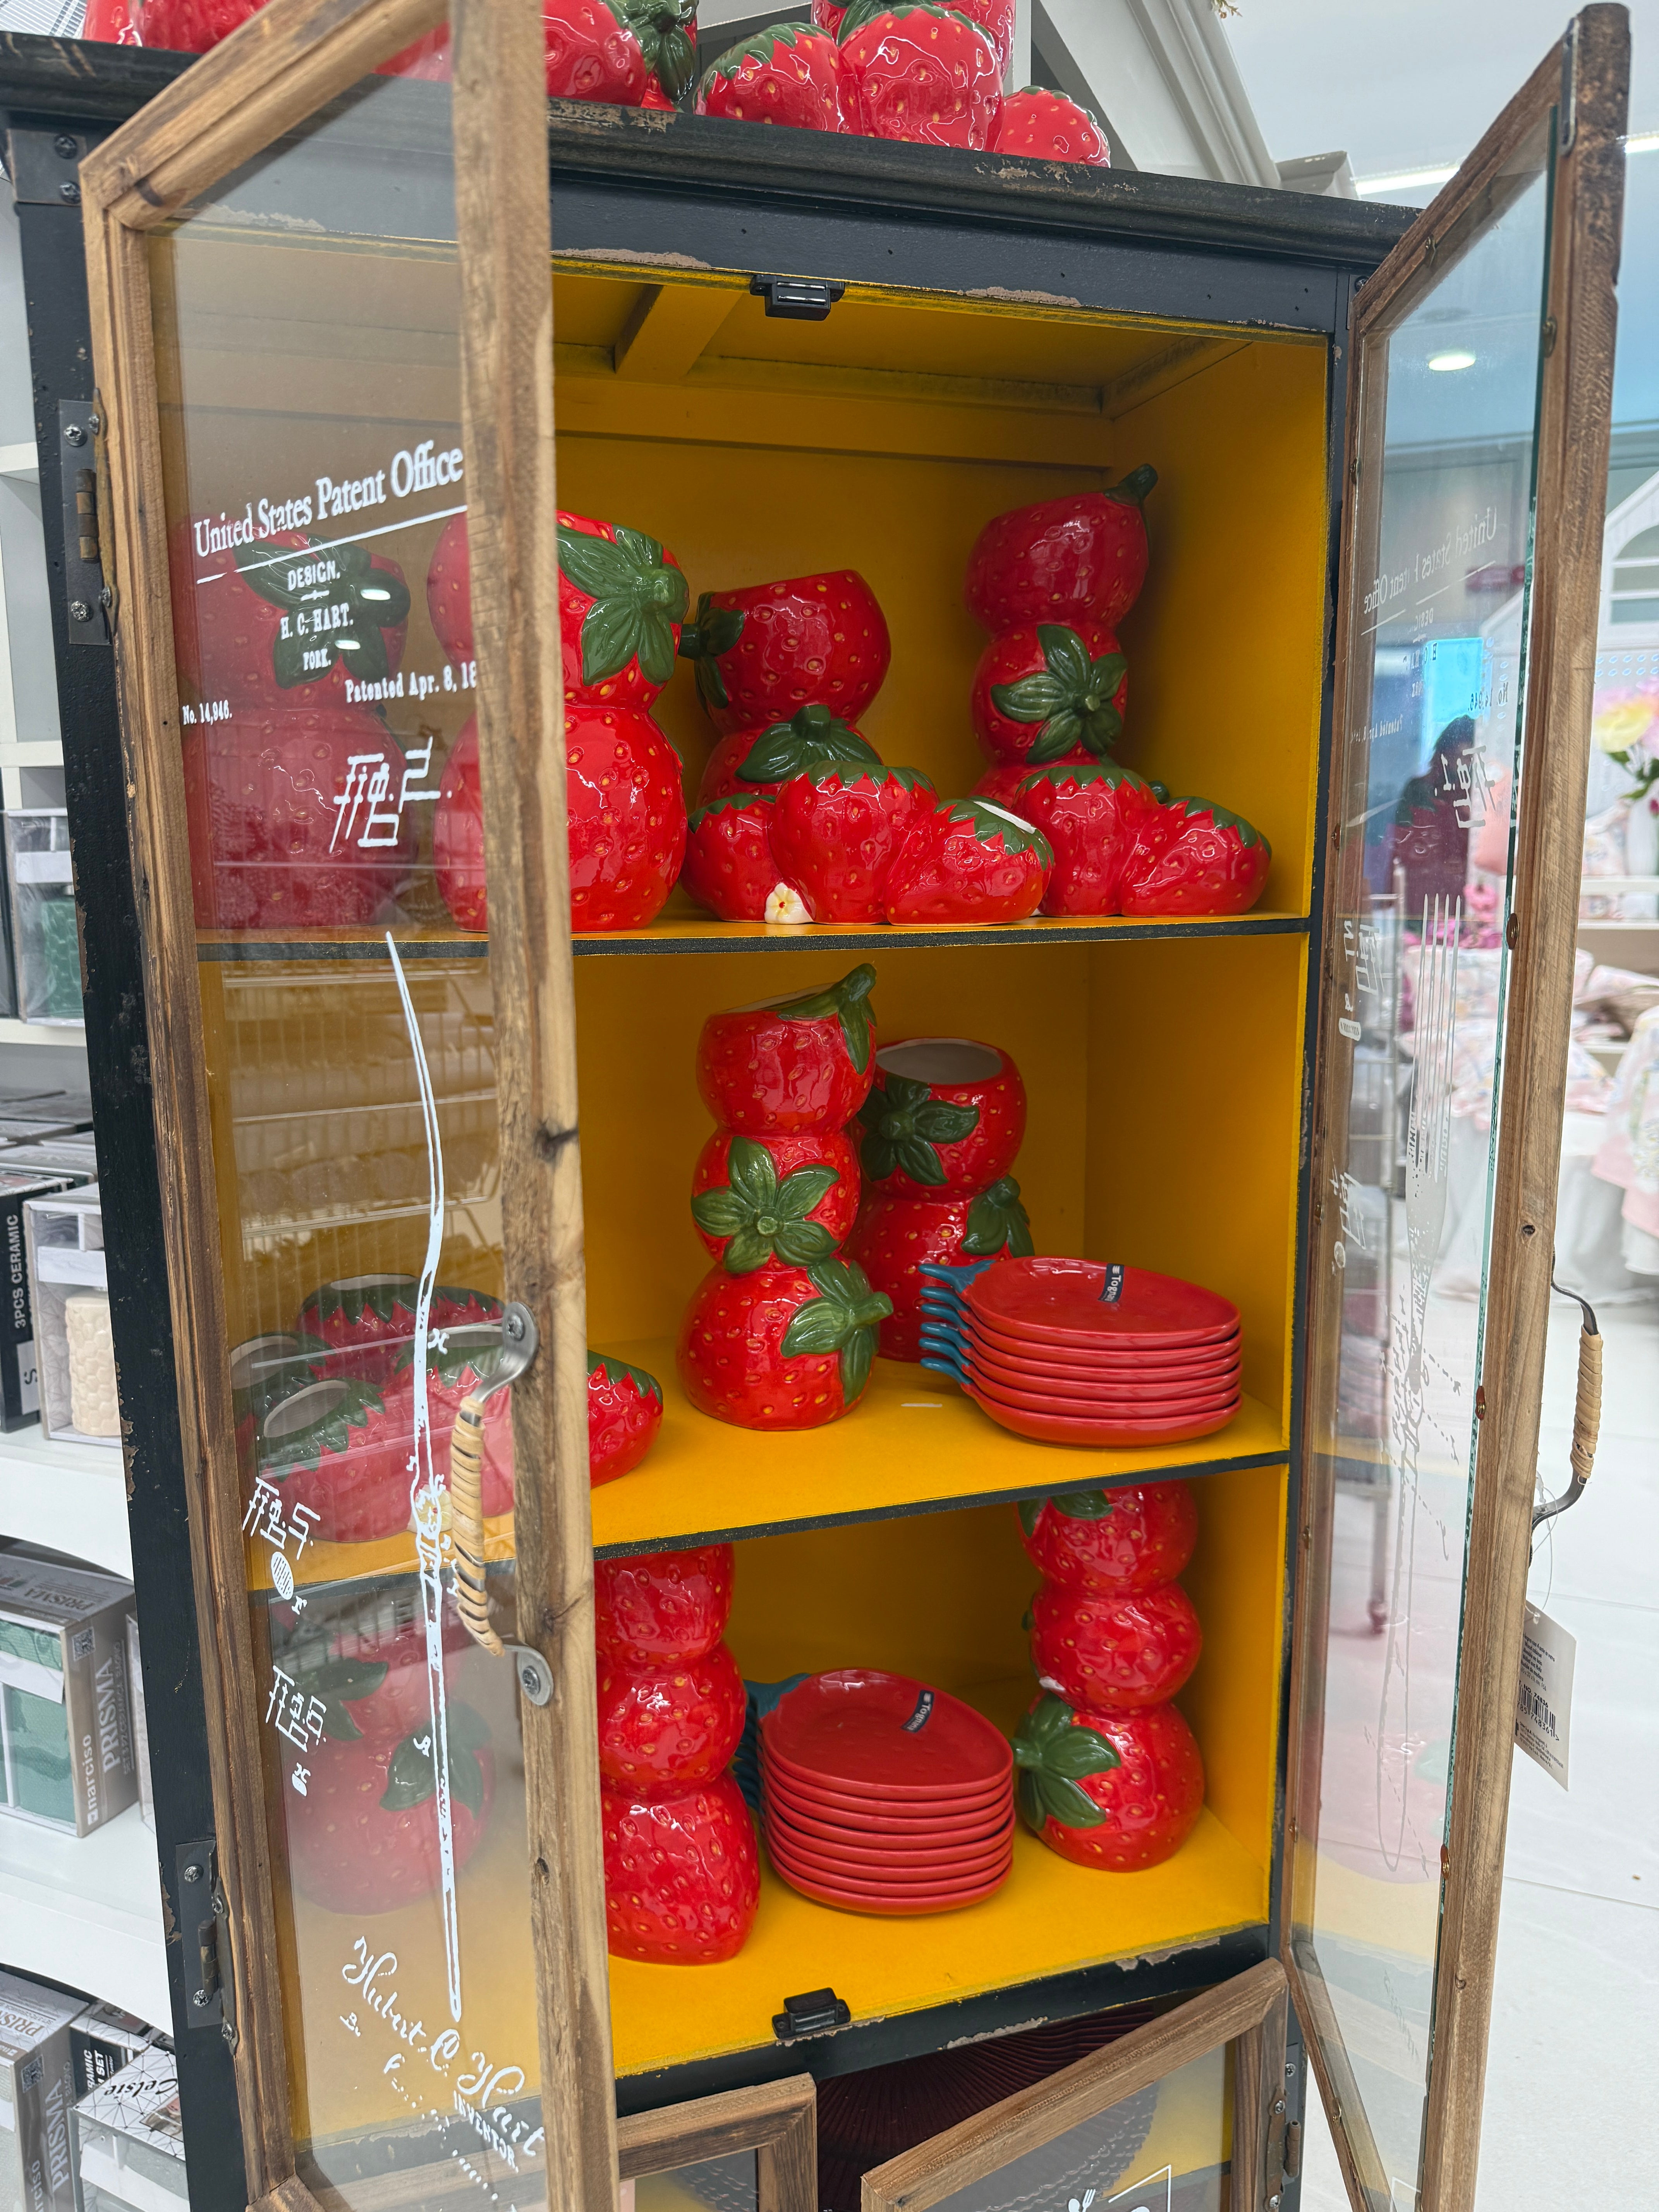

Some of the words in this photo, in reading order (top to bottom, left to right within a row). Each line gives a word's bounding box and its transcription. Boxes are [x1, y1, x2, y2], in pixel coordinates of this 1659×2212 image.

[194, 503, 254, 557] United
[258, 496, 312, 539] States
[316, 470, 386, 520] Patent
[390, 439, 464, 498] Office
[287, 560, 341, 591] DESIGN.
[313, 602, 354, 632] HART.
[344, 672, 404, 703] Patented
[409, 672, 440, 701] Apr.
[460, 660, 477, 690] 18
[182, 704, 197, 725] No.
[199, 699, 232, 725] 14,946.
[6, 1214, 23, 1284] CERAMIC
[13, 1287, 26, 1329] 3PCS
[95, 1657, 121, 1773] PRISMA
[83, 1734, 97, 1810] narciso
[83, 2049, 96, 2091] RAMIC
[94, 2049, 105, 2077] SET
[104, 2078, 178, 2099] Celsie
[45, 2078, 70, 2193] PRISMA
[31, 2159, 44, 2212] rciso
